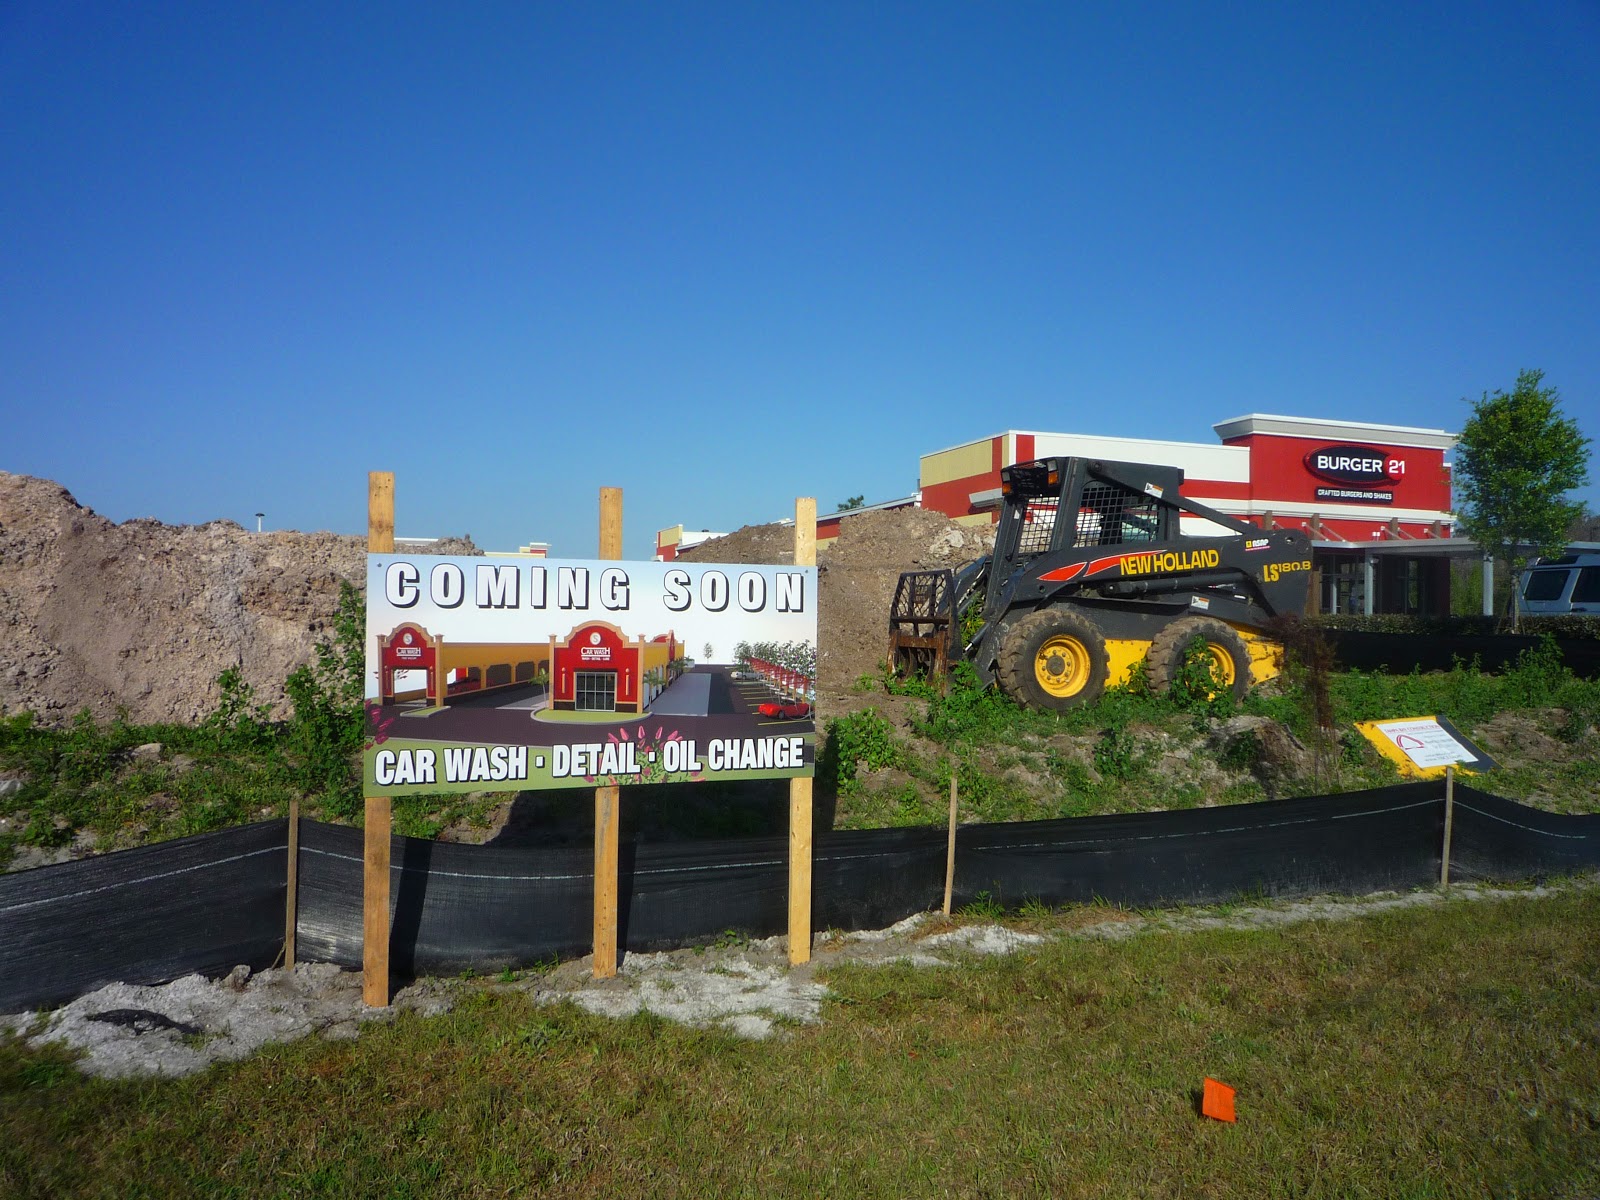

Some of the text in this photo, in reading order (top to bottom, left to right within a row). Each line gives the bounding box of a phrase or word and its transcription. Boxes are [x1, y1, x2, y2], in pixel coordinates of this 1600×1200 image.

[1317, 455, 1405, 474] BURGER 21
[1317, 489, 1392, 500] CRAFTED BURGERS AND SHAKES
[1119, 549, 1220, 576] NEW HOLLAND
[1263, 560, 1312, 583] LS180.B
[385, 562, 805, 612] COMING SOON
[581, 647, 611, 655] CAR WASH
[374, 736, 804, 786] CAR WASH DETAIL OIL CHANGE
